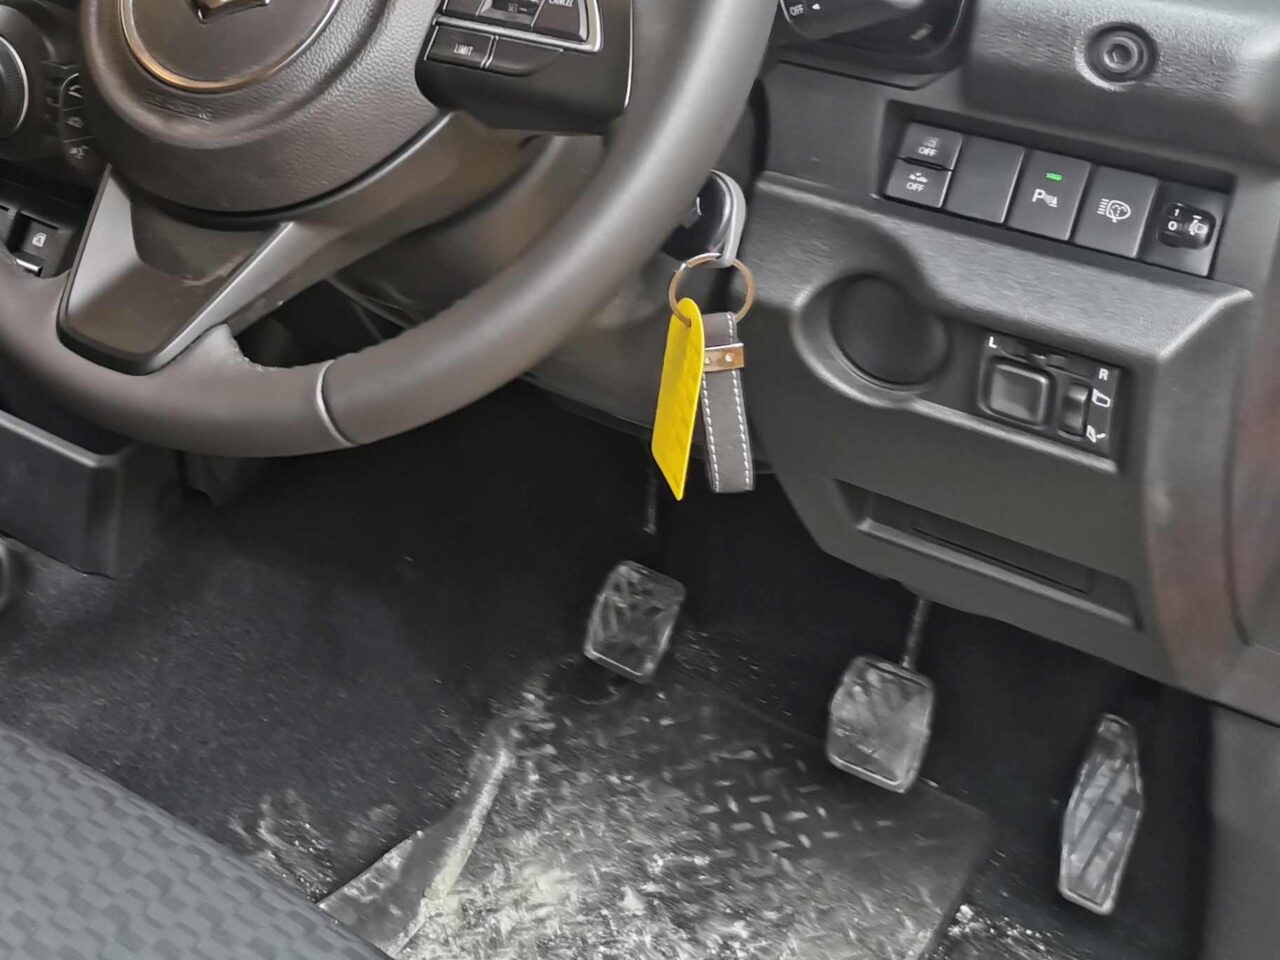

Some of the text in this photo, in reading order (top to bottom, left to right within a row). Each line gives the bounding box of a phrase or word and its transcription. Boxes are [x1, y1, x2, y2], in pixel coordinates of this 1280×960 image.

[789, 4, 804, 16] OFF
[453, 43, 473, 56] LIMIT
[918, 146, 938, 157] OFF
[906, 181, 926, 192] OFF
[988, 336, 998, 349] L
[1098, 368, 1109, 381] R
